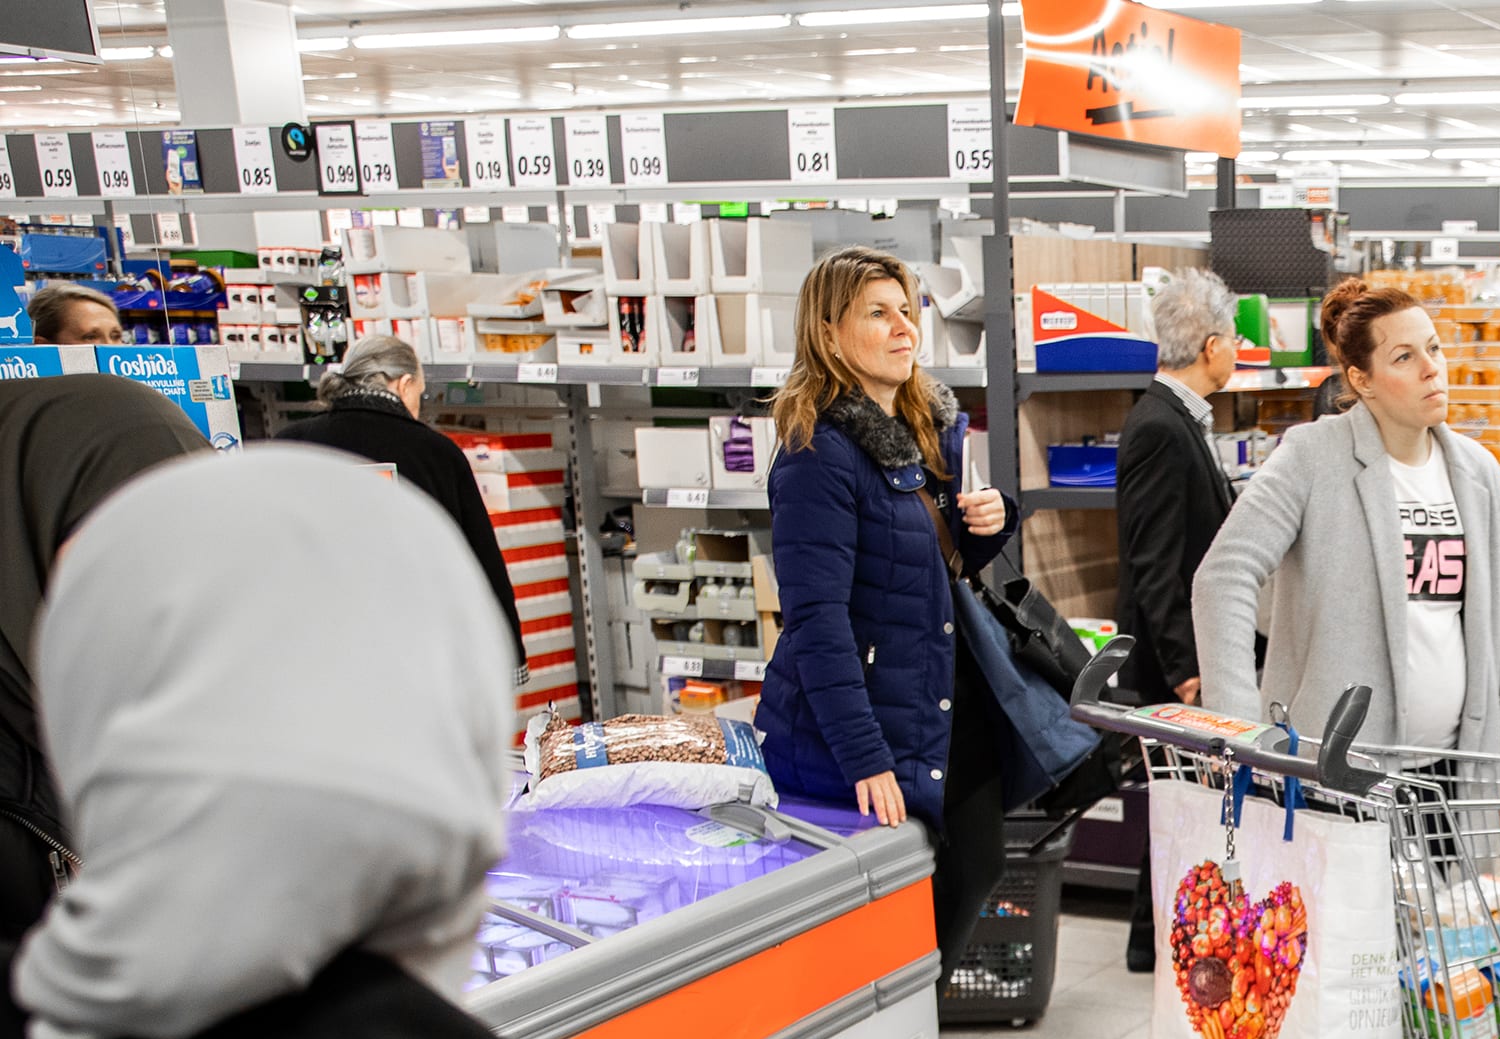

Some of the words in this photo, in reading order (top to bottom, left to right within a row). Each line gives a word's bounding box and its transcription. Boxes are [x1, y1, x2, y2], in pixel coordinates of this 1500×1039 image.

[518, 155, 551, 176] 0.59
[573, 159, 604, 178] 0.39
[629, 157, 661, 176] 0.99
[797, 152, 830, 172] 0.81
[955, 149, 993, 170] 0.55
[44, 169, 72, 187] 0.59
[103, 170, 129, 188] 0.99
[242, 168, 272, 186] 0.85
[326, 165, 355, 183] 0.99
[362, 164, 392, 182] 0.79
[475, 161, 502, 180] 0.19
[108, 353, 178, 378] Coshida
[1352, 953, 1386, 966] DENK
[1351, 966, 1373, 979] HET
